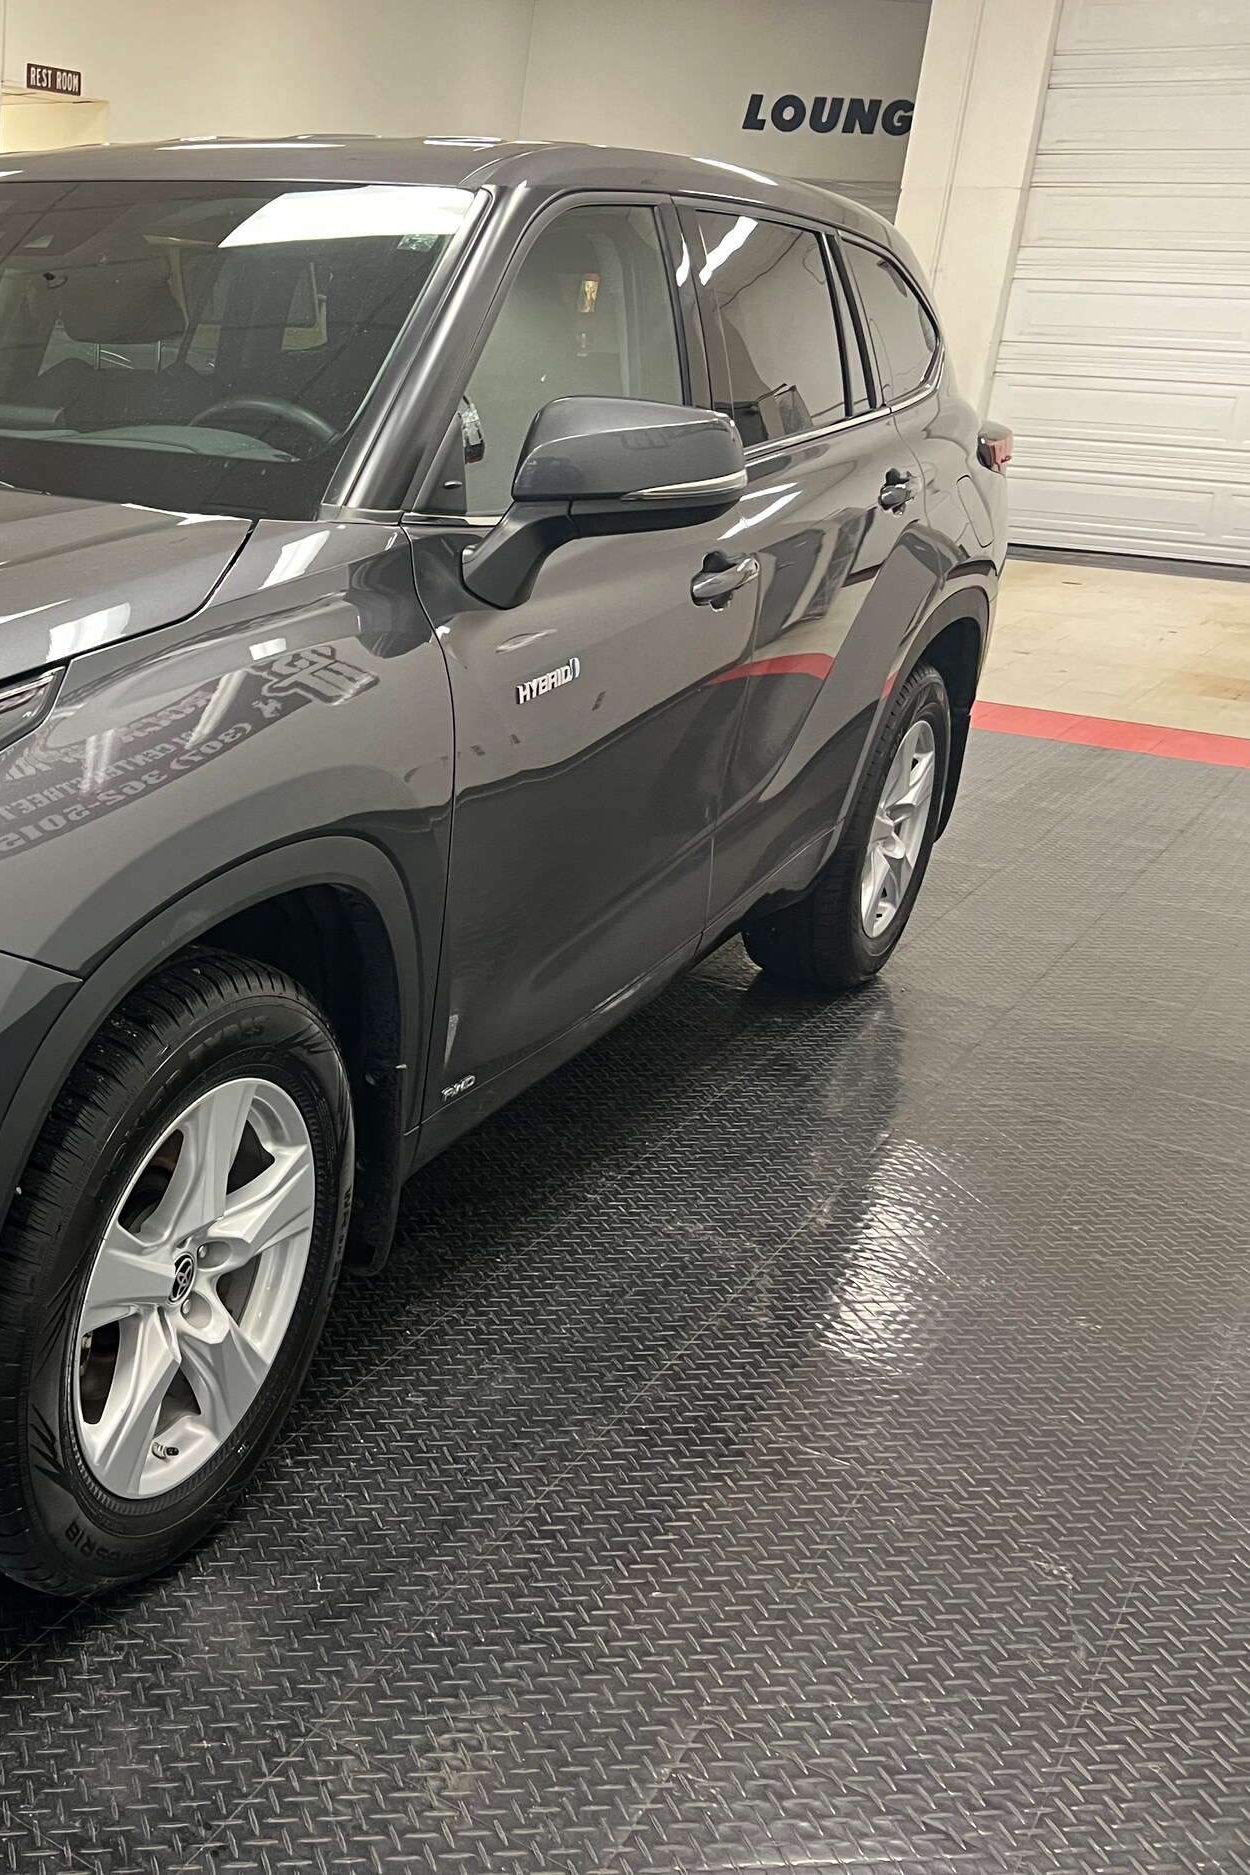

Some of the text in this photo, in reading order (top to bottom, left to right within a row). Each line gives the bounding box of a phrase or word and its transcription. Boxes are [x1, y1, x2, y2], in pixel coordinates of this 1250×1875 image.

[30, 67, 79, 92] REST ROOM
[742, 94, 915, 136] LOUNG
[516, 660, 576, 705] HYBRID
